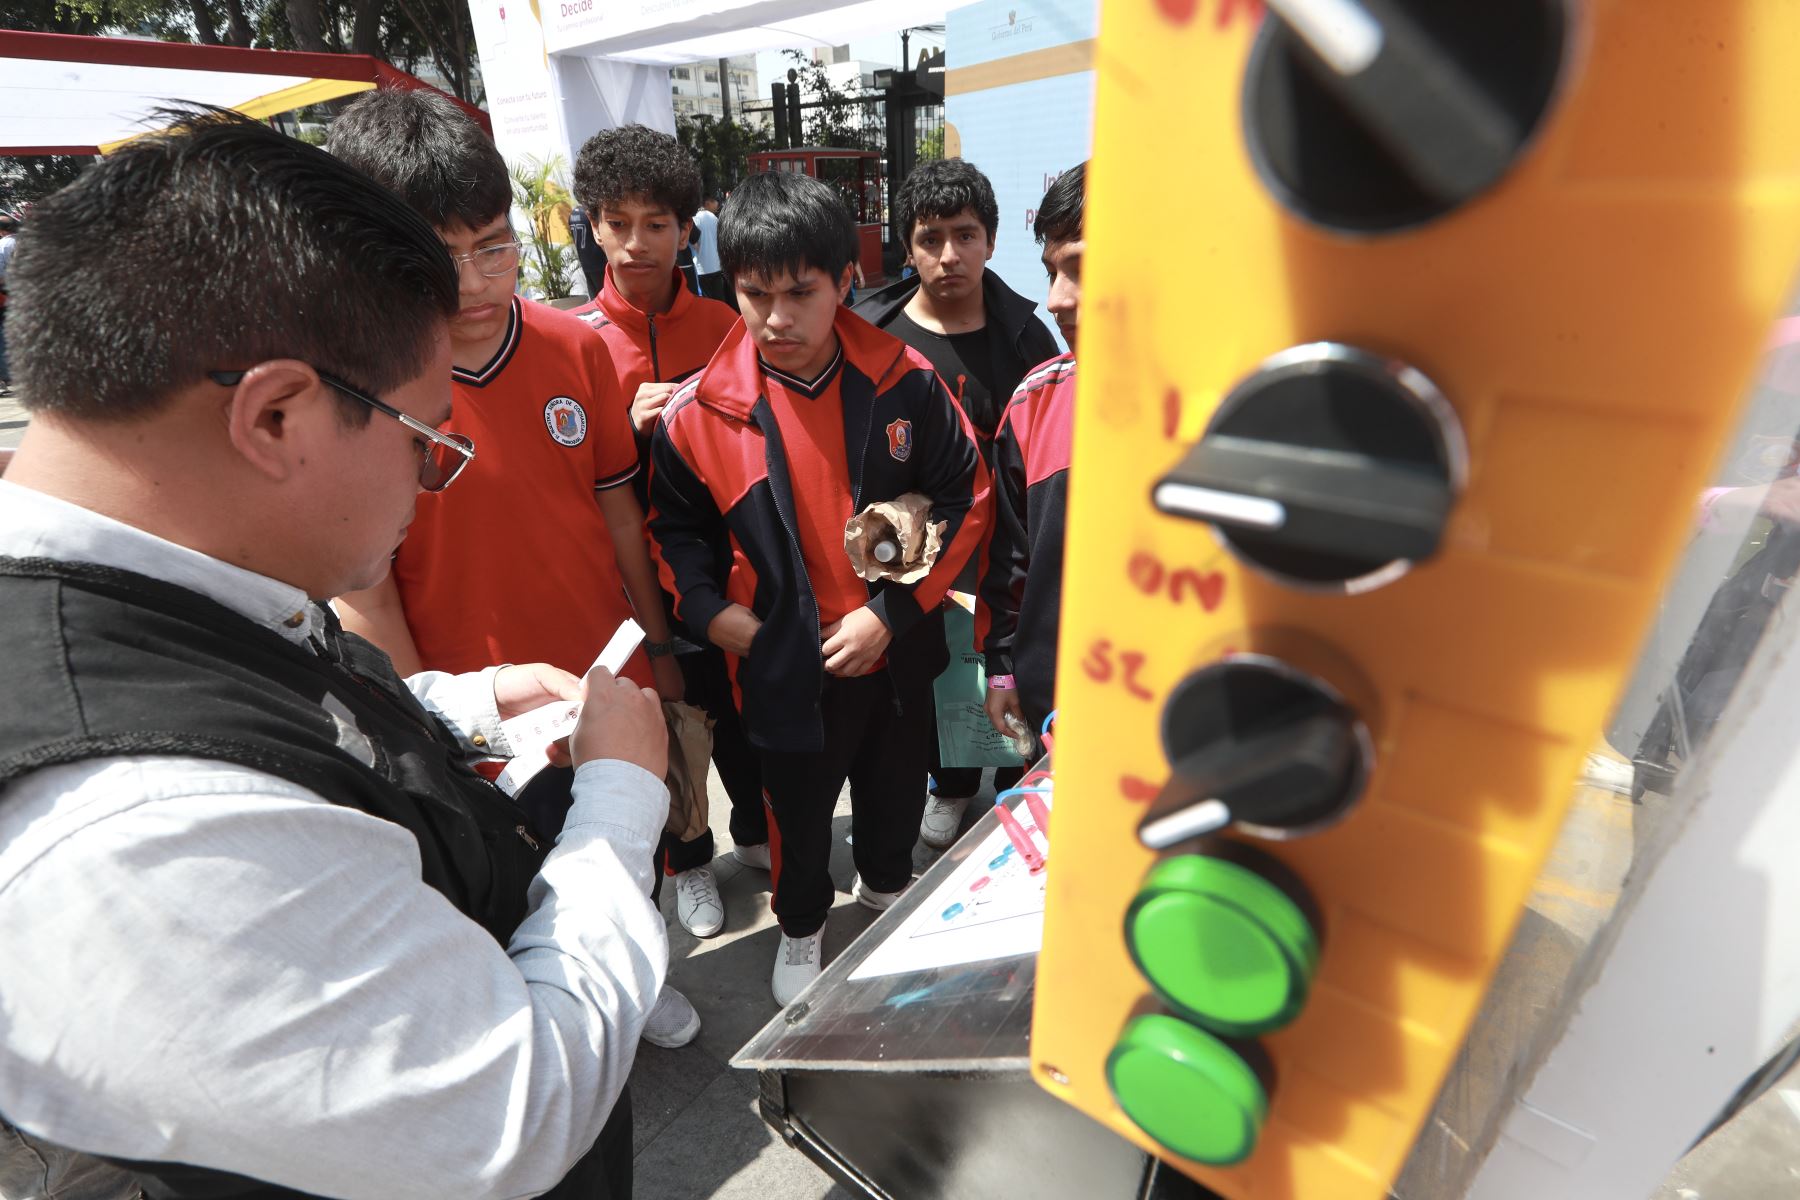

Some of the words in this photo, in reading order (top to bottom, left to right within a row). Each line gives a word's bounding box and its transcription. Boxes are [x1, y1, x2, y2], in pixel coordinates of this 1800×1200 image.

[560, 0, 593, 17] Decide
[496, 95, 516, 105] Conecta
[516, 94, 525, 102] con
[565, 399, 573, 407] DE
